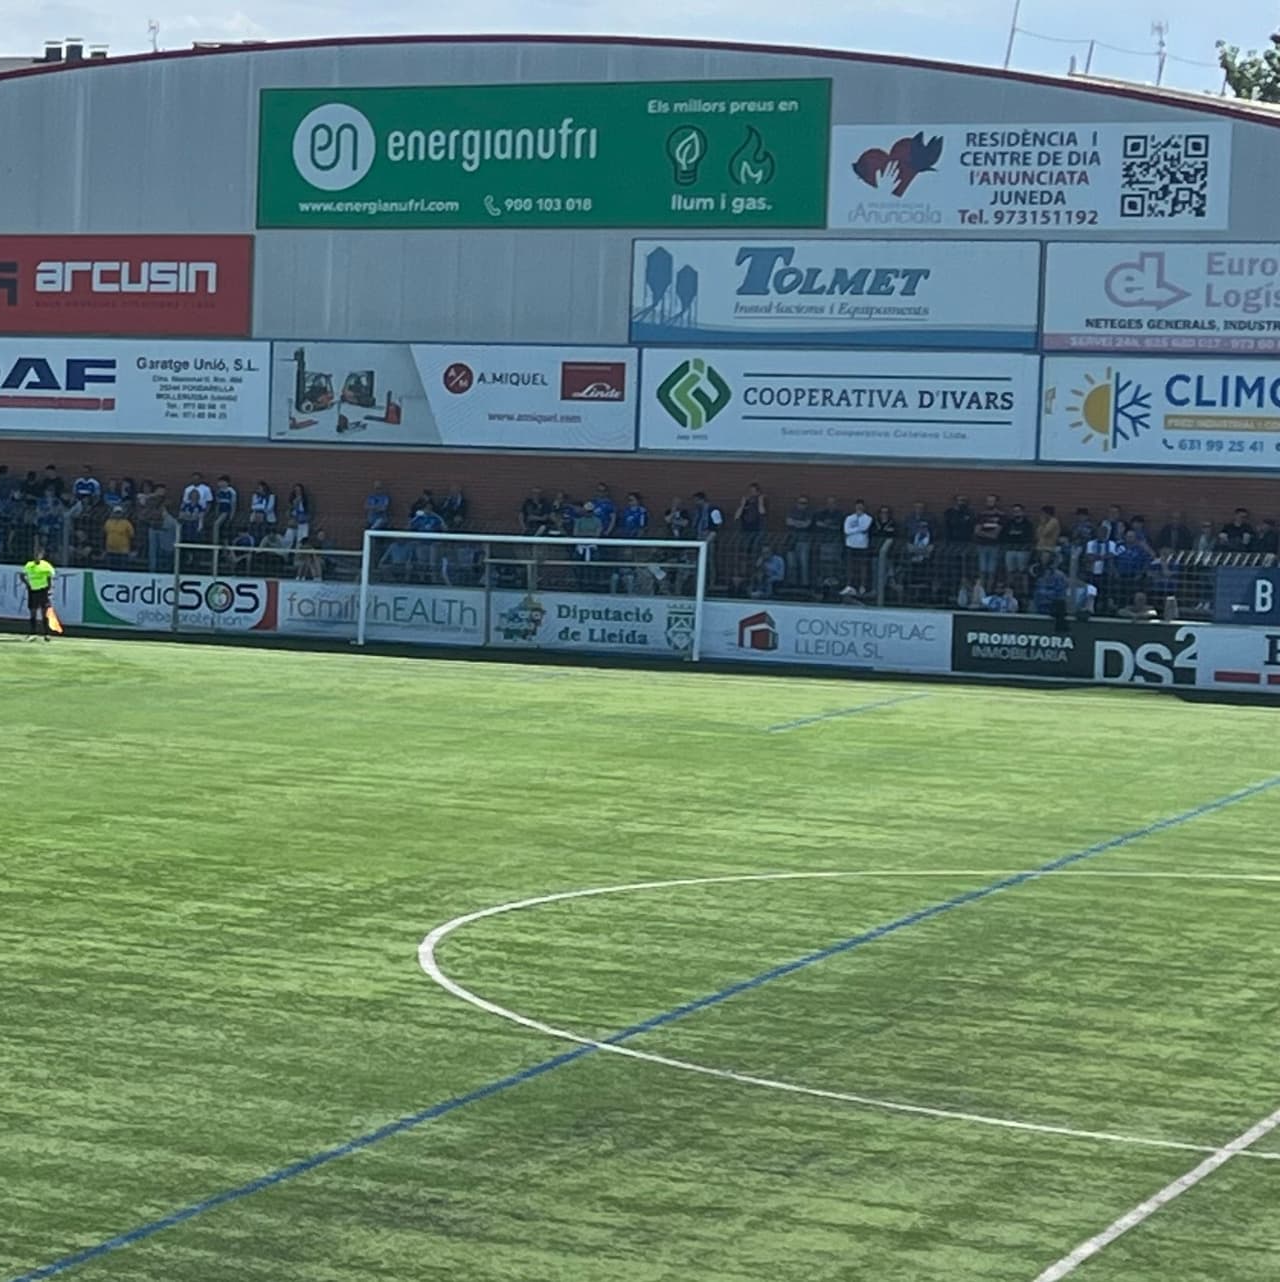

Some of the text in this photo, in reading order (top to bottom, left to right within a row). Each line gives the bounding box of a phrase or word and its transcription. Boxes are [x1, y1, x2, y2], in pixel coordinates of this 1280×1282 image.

[647, 99, 800, 115] Els millors preus en
[388, 117, 597, 172] energianufri
[966, 129, 1078, 147] RESIDÈNCIA
[960, 151, 1101, 167] CENTRE DE DIA
[298, 198, 592, 215] www.energianufri.com 900 103 018
[671, 193, 773, 214] llum i gas.
[990, 190, 1066, 206] JUNEDA
[958, 208, 1099, 225] Tel. 973151192
[35, 261, 217, 293] arcusin
[735, 246, 931, 296] TOLMET
[1085, 318, 1144, 330] NETEGES
[1147, 319, 1220, 332] GENERALS,
[136, 357, 190, 373] Garatge
[194, 358, 230, 373] Unió,
[477, 372, 549, 387] A.MIQUEL
[572, 383, 622, 399] Linde
[742, 387, 1014, 411] COOPERATIVA D'IVARS
[1206, 440, 1224, 452] 99
[1248, 441, 1264, 453] 41
[100, 578, 260, 614] cardioSOS
[1255, 579, 1273, 612] B
[557, 604, 653, 624] Diputació
[559, 627, 649, 646] de Lleida
[795, 618, 936, 642] CONSTRUPLAC
[795, 639, 884, 660] LLEIDA SL
[967, 631, 1074, 650] PROMOTORA
[971, 646, 1069, 663] INMOBILIARIA
